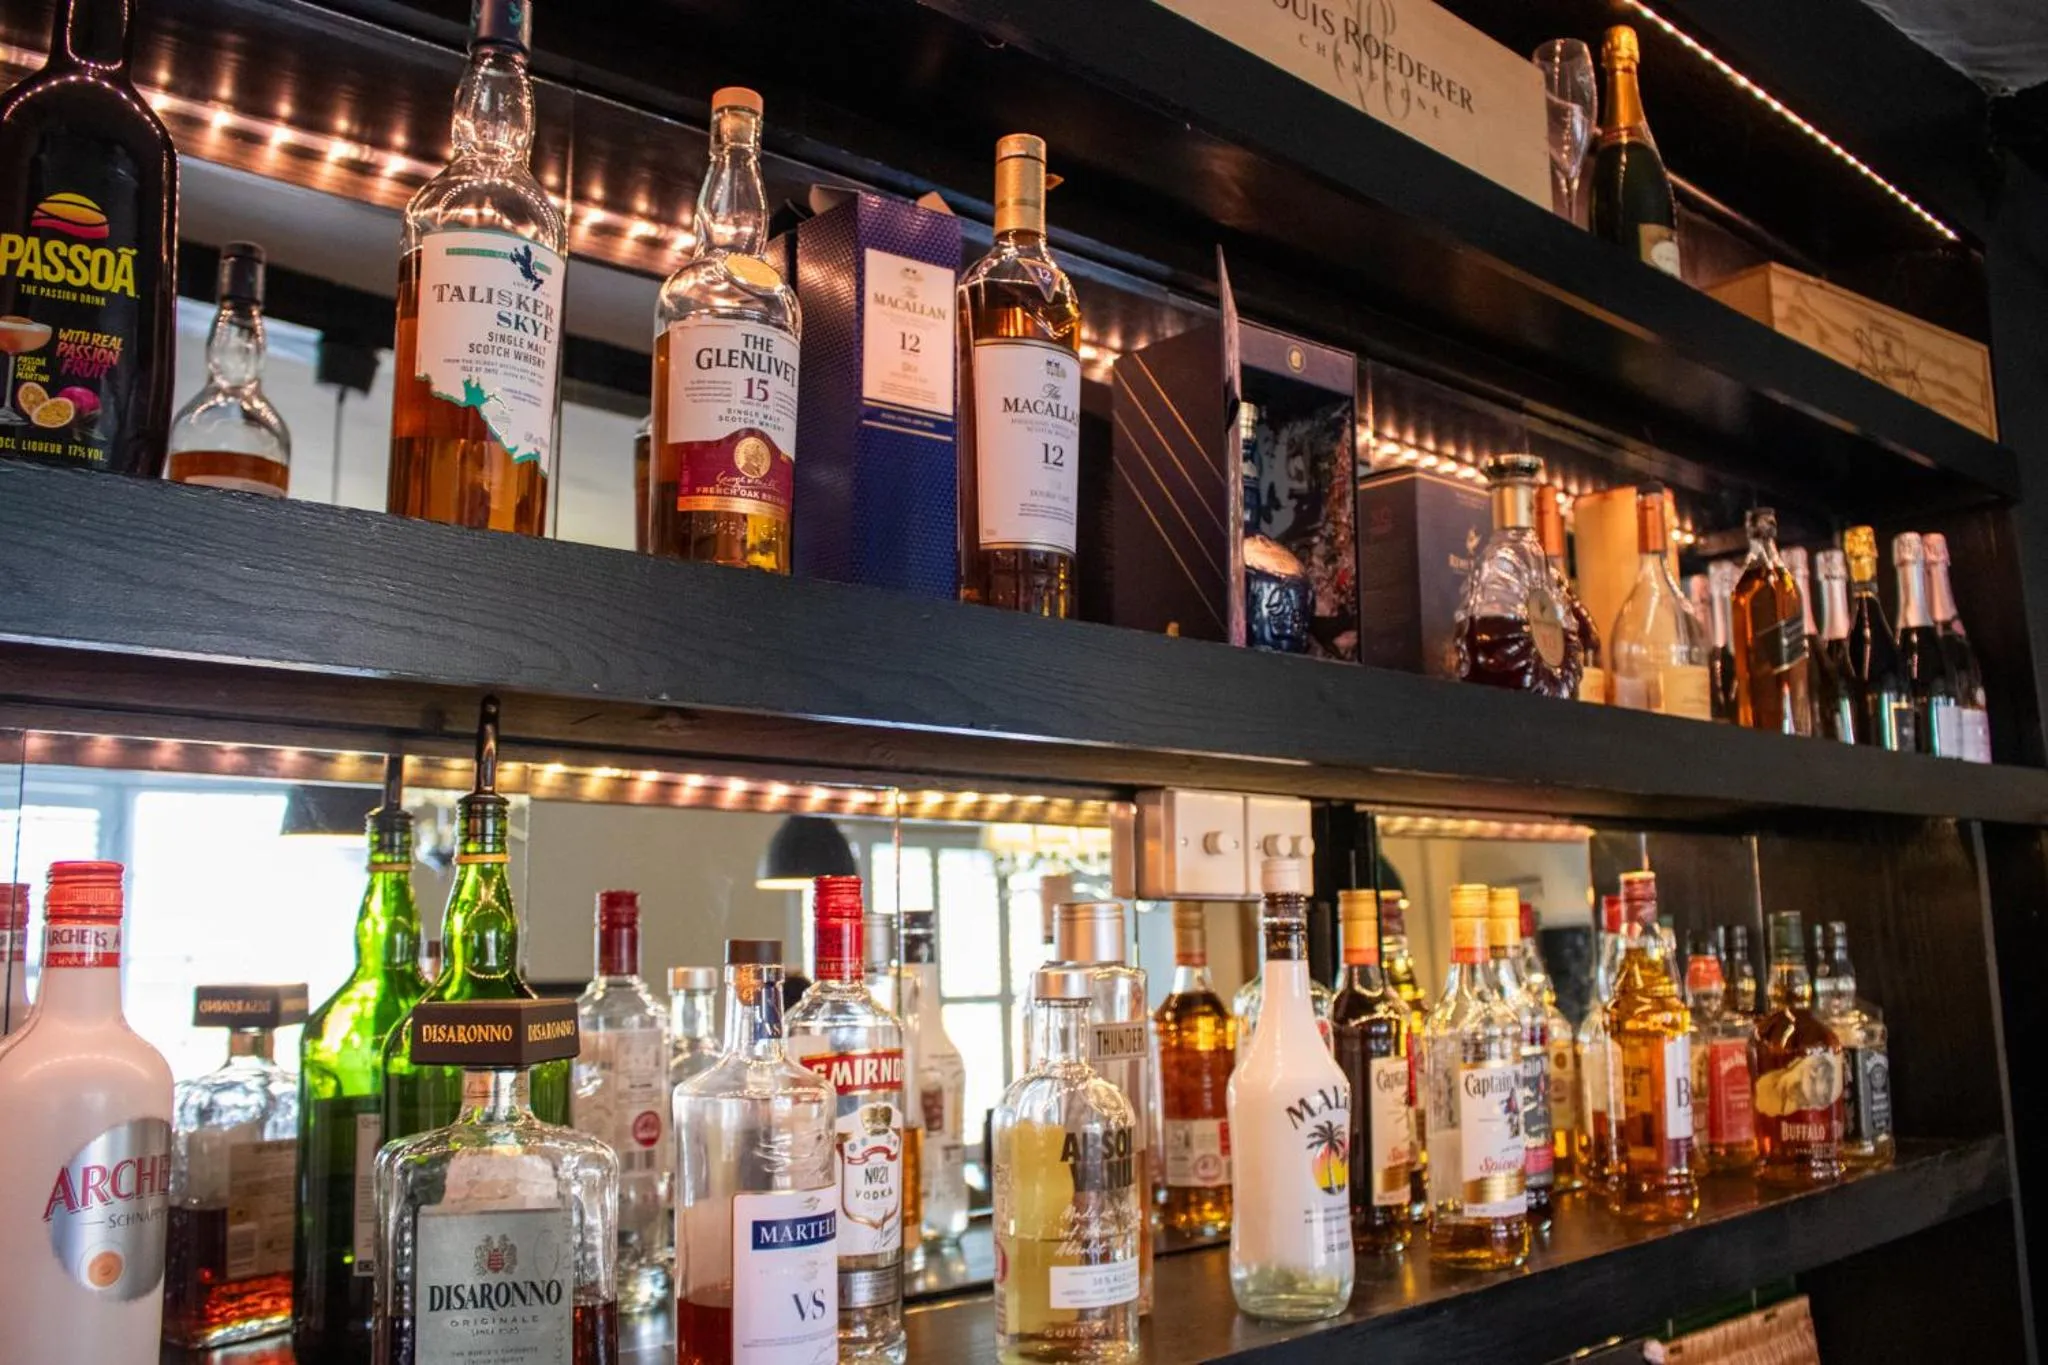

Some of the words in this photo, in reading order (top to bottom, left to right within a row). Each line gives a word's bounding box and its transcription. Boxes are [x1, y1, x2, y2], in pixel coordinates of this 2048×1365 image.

[1344, 16, 1475, 114] ROEDERER
[0, 233, 138, 298] PASSOÃ
[433, 283, 554, 323] TALISKER
[874, 292, 947, 320] MACALLAN
[58, 328, 90, 343] WITH
[91, 333, 123, 350] REAL
[497, 310, 554, 344] SKYE
[56, 341, 123, 365] PASSION
[488, 331, 524, 347] SINGLE
[527, 340, 546, 356] MALT
[741, 333, 774, 353] THE
[900, 332, 921, 353] 12
[61, 359, 111, 378] FRUIT
[469, 342, 510, 359] SCOTCH
[514, 351, 546, 370] WHISKY
[696, 348, 796, 388] GLENLIVET
[744, 377, 769, 402] 15
[718, 415, 755, 425] SCOTCH
[1042, 442, 1064, 467] 12
[696, 486, 737, 496] FRENCH
[740, 488, 760, 499] OAK
[423, 1024, 513, 1044] DISARONNO
[528, 1019, 575, 1043] DISARONNO
[1096, 1028, 1144, 1057] THUNDER
[1465, 1071, 1512, 1098] Captain
[1781, 1121, 1826, 1141] BUFFALO
[855, 1186, 893, 1200] VODKA
[428, 1279, 562, 1313] DISARONNO
[792, 1288, 826, 1321] VS
[450, 1315, 540, 1328] ORIGINALE
